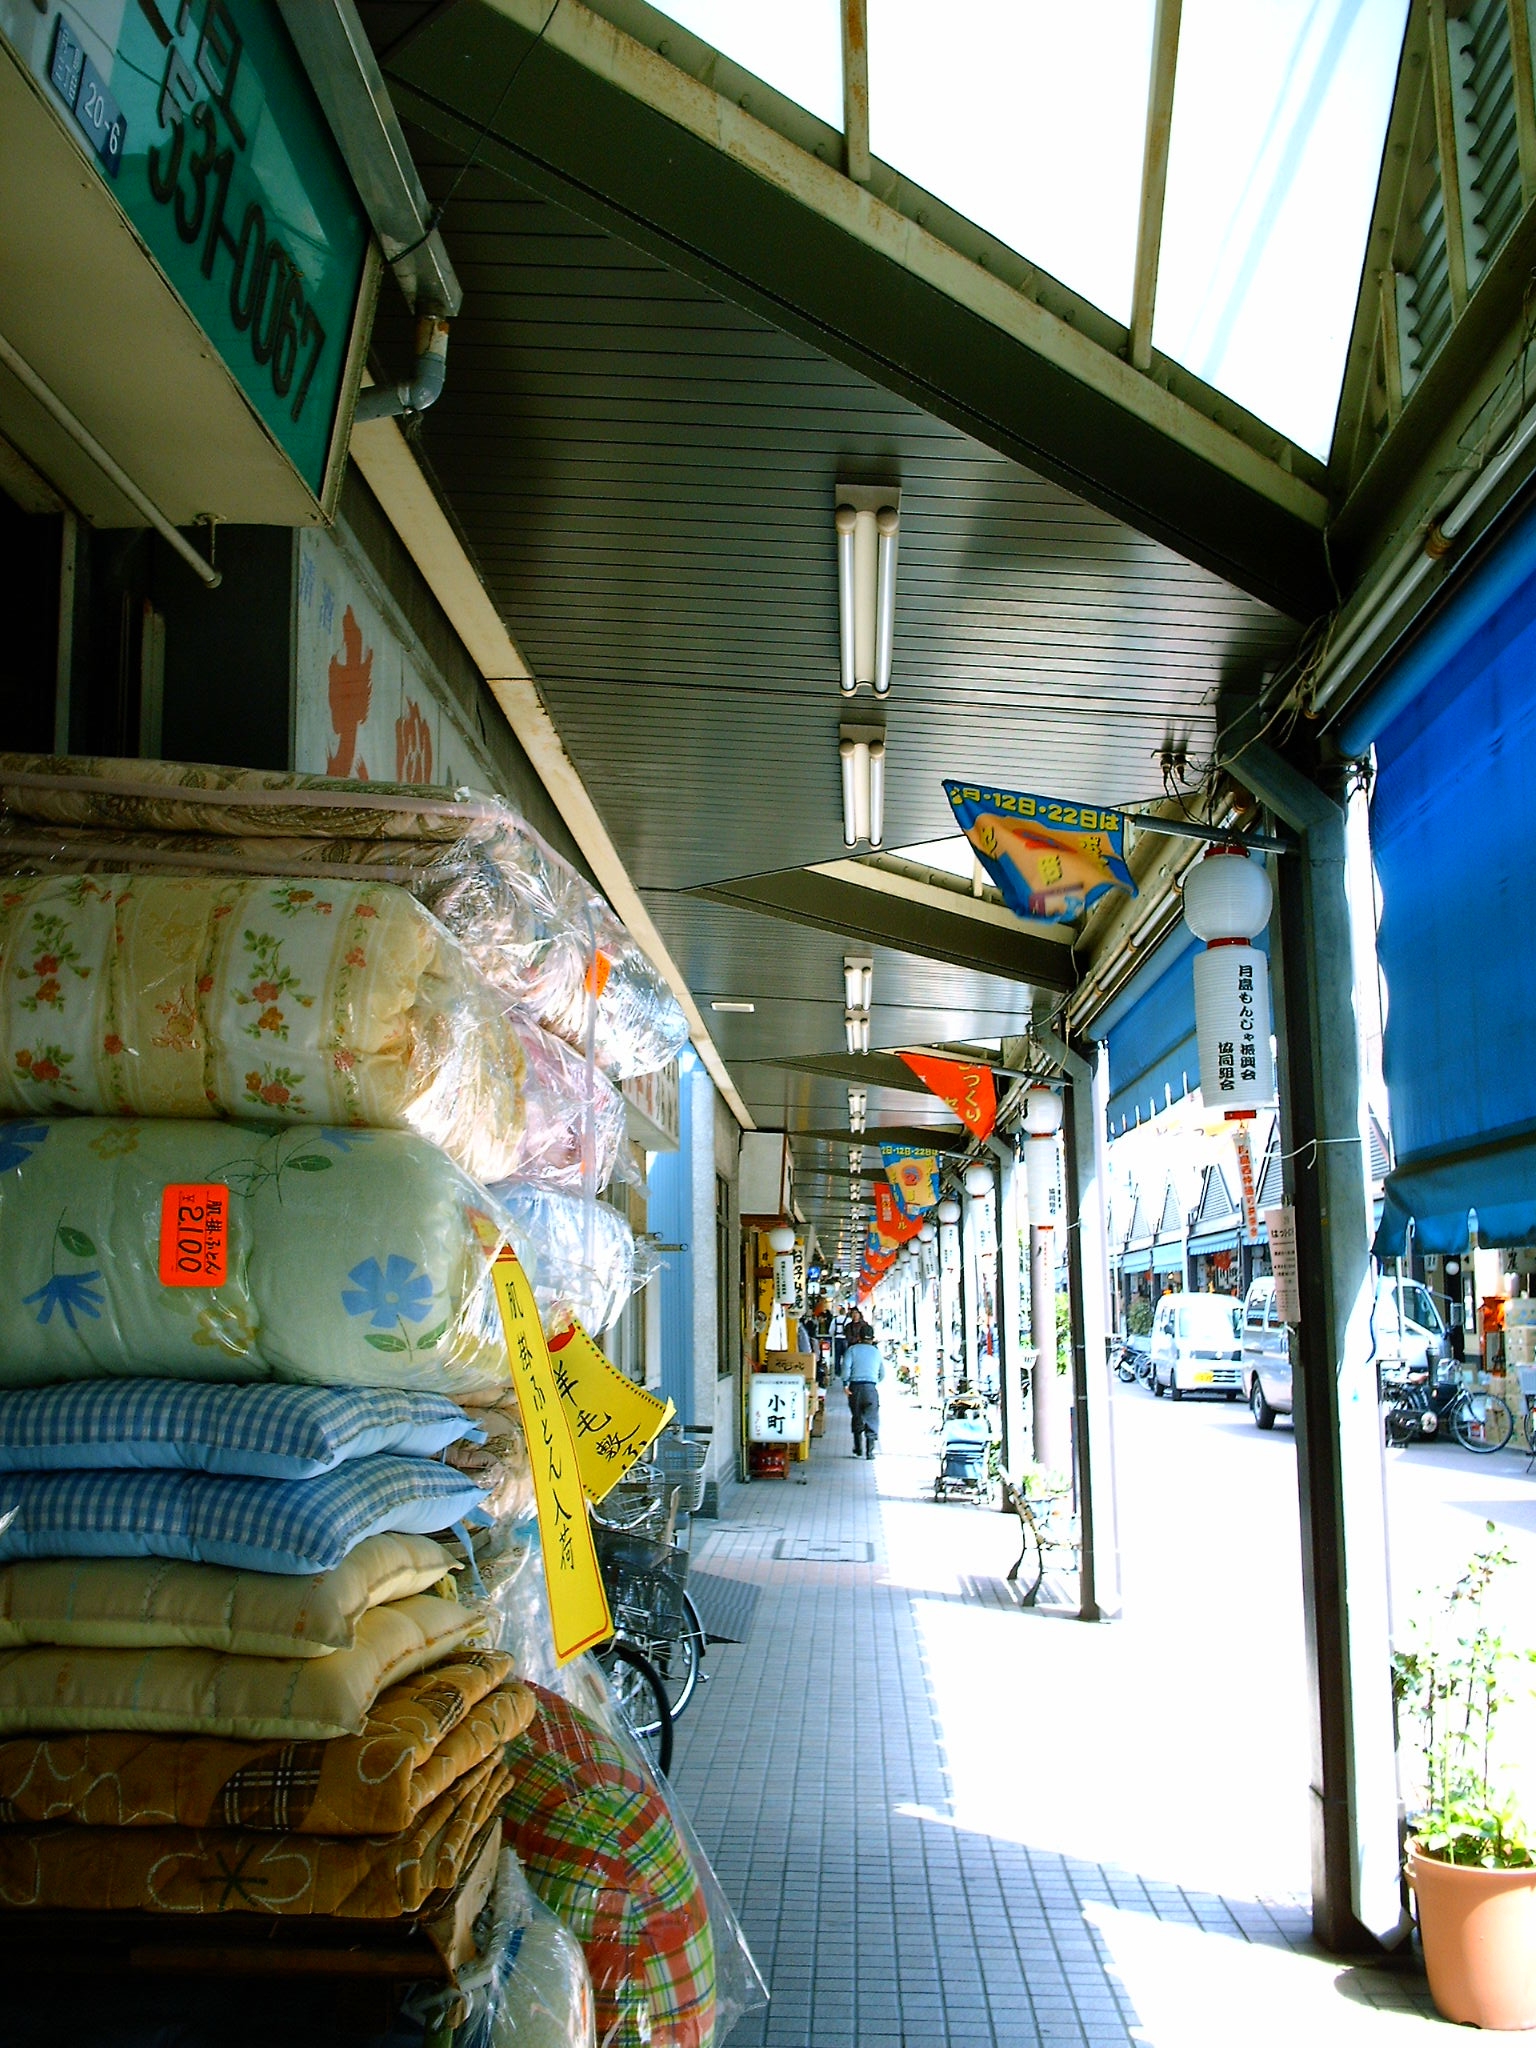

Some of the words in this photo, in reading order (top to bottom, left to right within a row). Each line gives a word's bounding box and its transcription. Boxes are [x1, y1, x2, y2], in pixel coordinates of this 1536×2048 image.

[84, 82, 120, 155] 20-6
[1238, 965, 1256, 1081] 月島もんじゃ振興会
[1218, 1042, 1235, 1091] 協同組合
[768, 1394, 786, 1434] 小町
